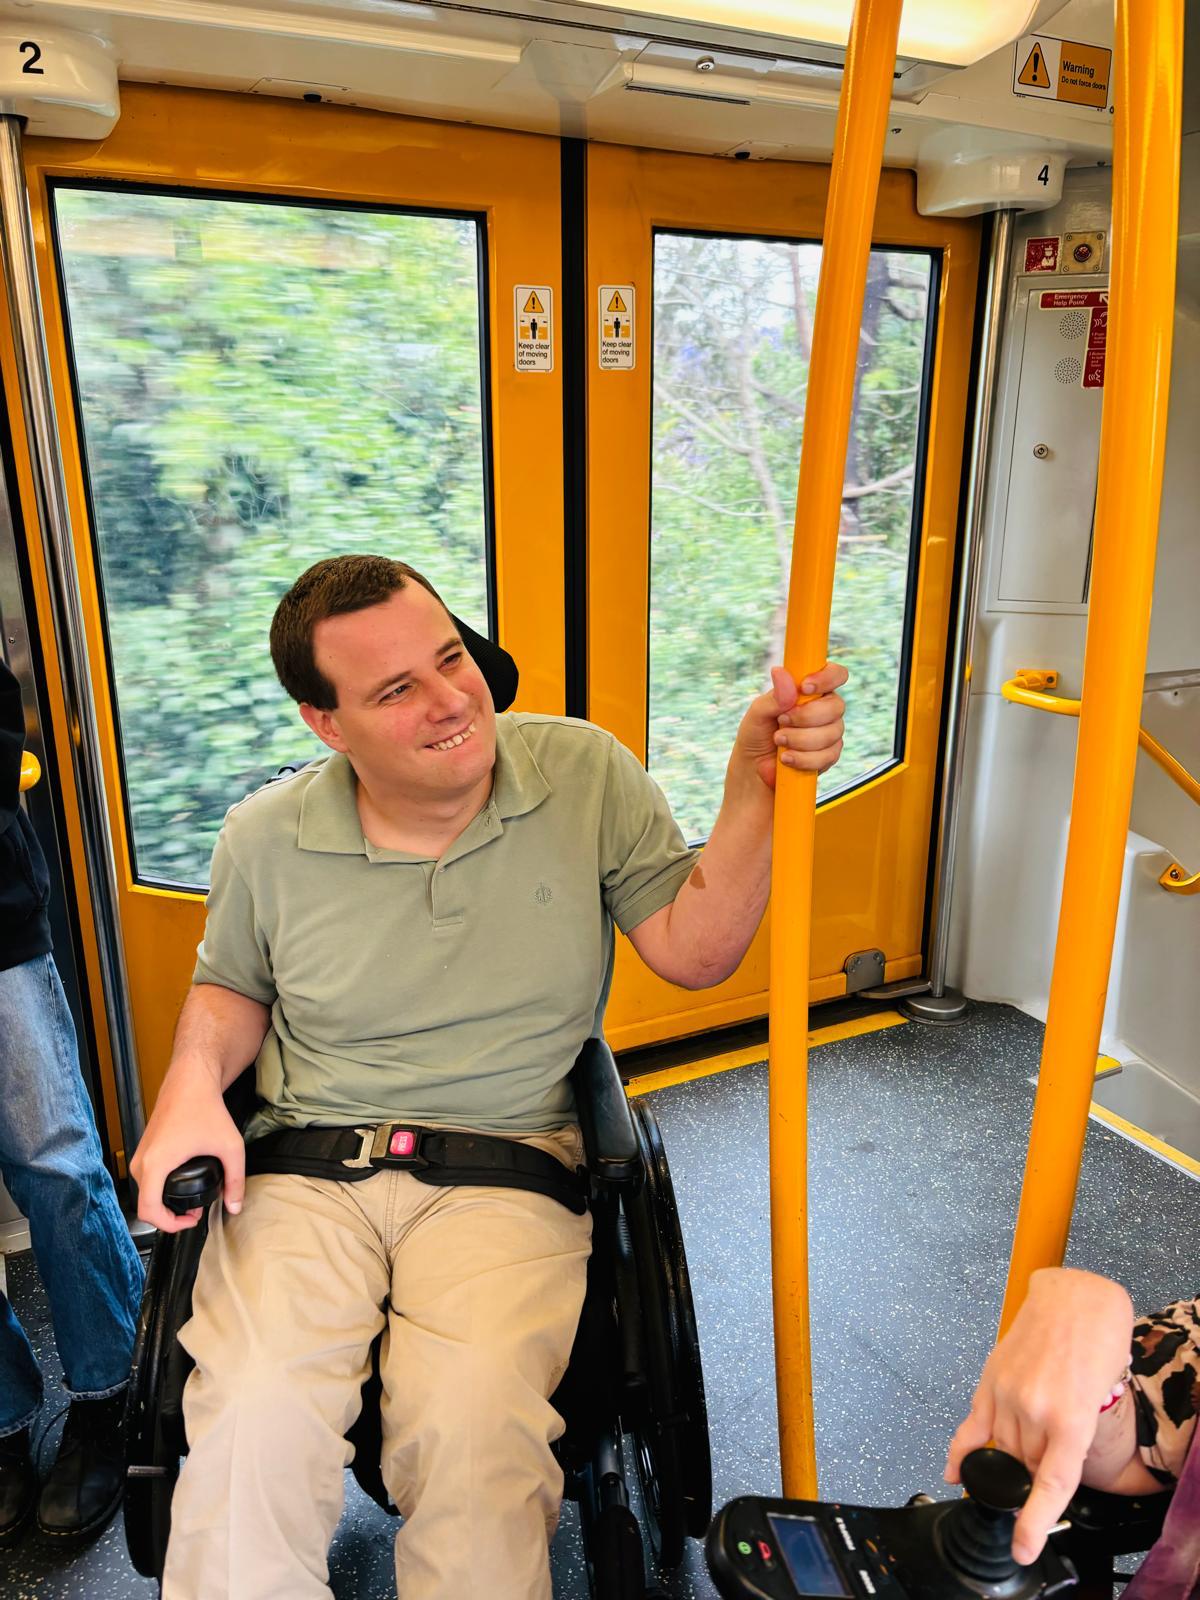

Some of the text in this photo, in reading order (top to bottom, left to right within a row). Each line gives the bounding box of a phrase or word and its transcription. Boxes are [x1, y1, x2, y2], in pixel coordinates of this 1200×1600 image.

[19, 41, 44, 74] 2
[1062, 60, 1095, 78] Warning
[1061, 75, 1106, 91] Do not force doors
[1037, 164, 1049, 186] 4
[1054, 293, 1088, 302] Emergency
[518, 343, 535, 351] Keep
[602, 341, 618, 349] Keep
[525, 351, 548, 360] moving
[609, 349, 630, 357] moving
[602, 356, 619, 364] doors
